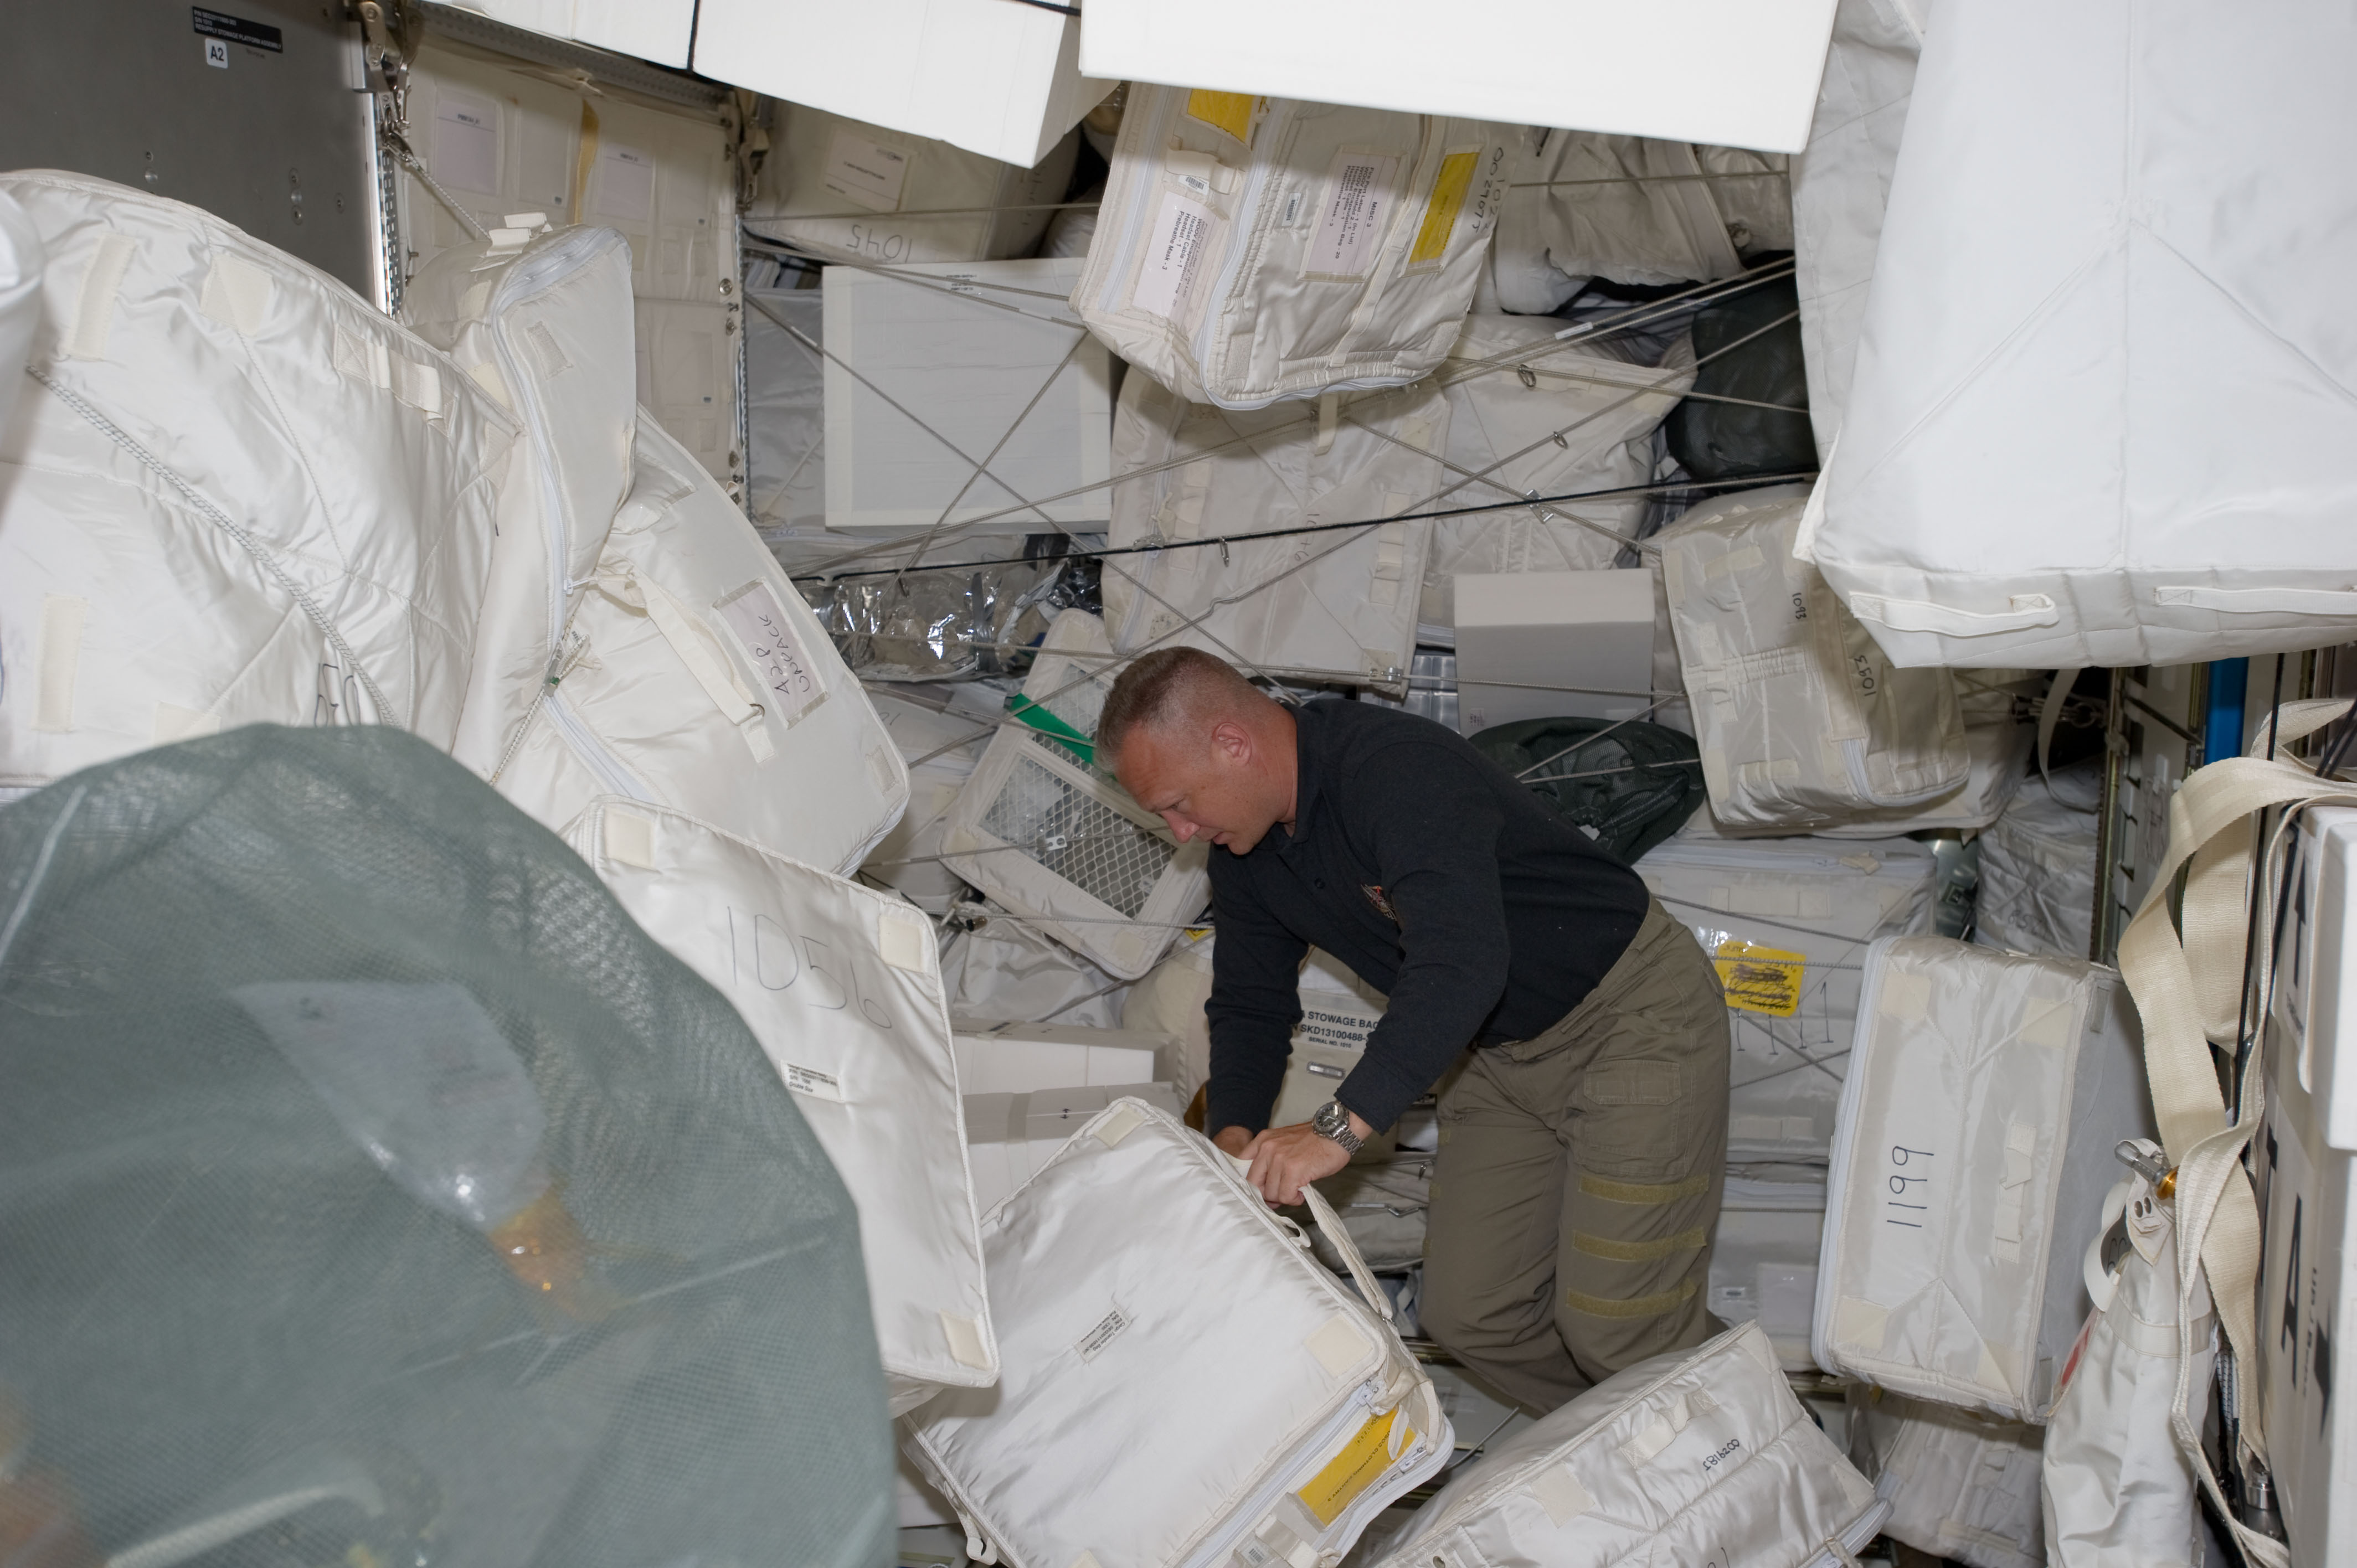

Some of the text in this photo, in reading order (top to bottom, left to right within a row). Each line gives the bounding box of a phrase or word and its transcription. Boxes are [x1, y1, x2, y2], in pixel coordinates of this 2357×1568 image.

[195, 23, 218, 34] RESUPPLY
[218, 29, 239, 39] STOWAGE
[239, 33, 261, 44] PLATFORM
[210, 45, 224, 61] A2
[1342, 189, 1357, 232] Encapsulation
[1343, 193, 1351, 211] Cable
[1352, 189, 1362, 215] Manifold
[1357, 196, 1366, 212] Label
[1368, 202, 1377, 220] MISC
[1170, 211, 1185, 244] Prebreathe
[1179, 214, 1190, 238] Headset
[1185, 216, 1197, 240] Headset
[847, 224, 912, 262] 1045
[1164, 246, 1174, 261] Mask
[1180, 242, 1188, 259] Cable
[1792, 591, 1807, 621] 1093
[759, 613, 810, 693] UNPACK
[1854, 653, 1876, 697] 1093
[726, 905, 893, 1029] 1056
[1308, 1011, 1356, 1027] STOWAGE
[1308, 1036, 1327, 1045] SERIAL
[1887, 1146, 1934, 1229] 1199
[1100, 1332, 1115, 1345] Transfer
[1114, 1322, 1125, 1332] Cargo
[1352, 1448, 1378, 1476] CLOTHING
